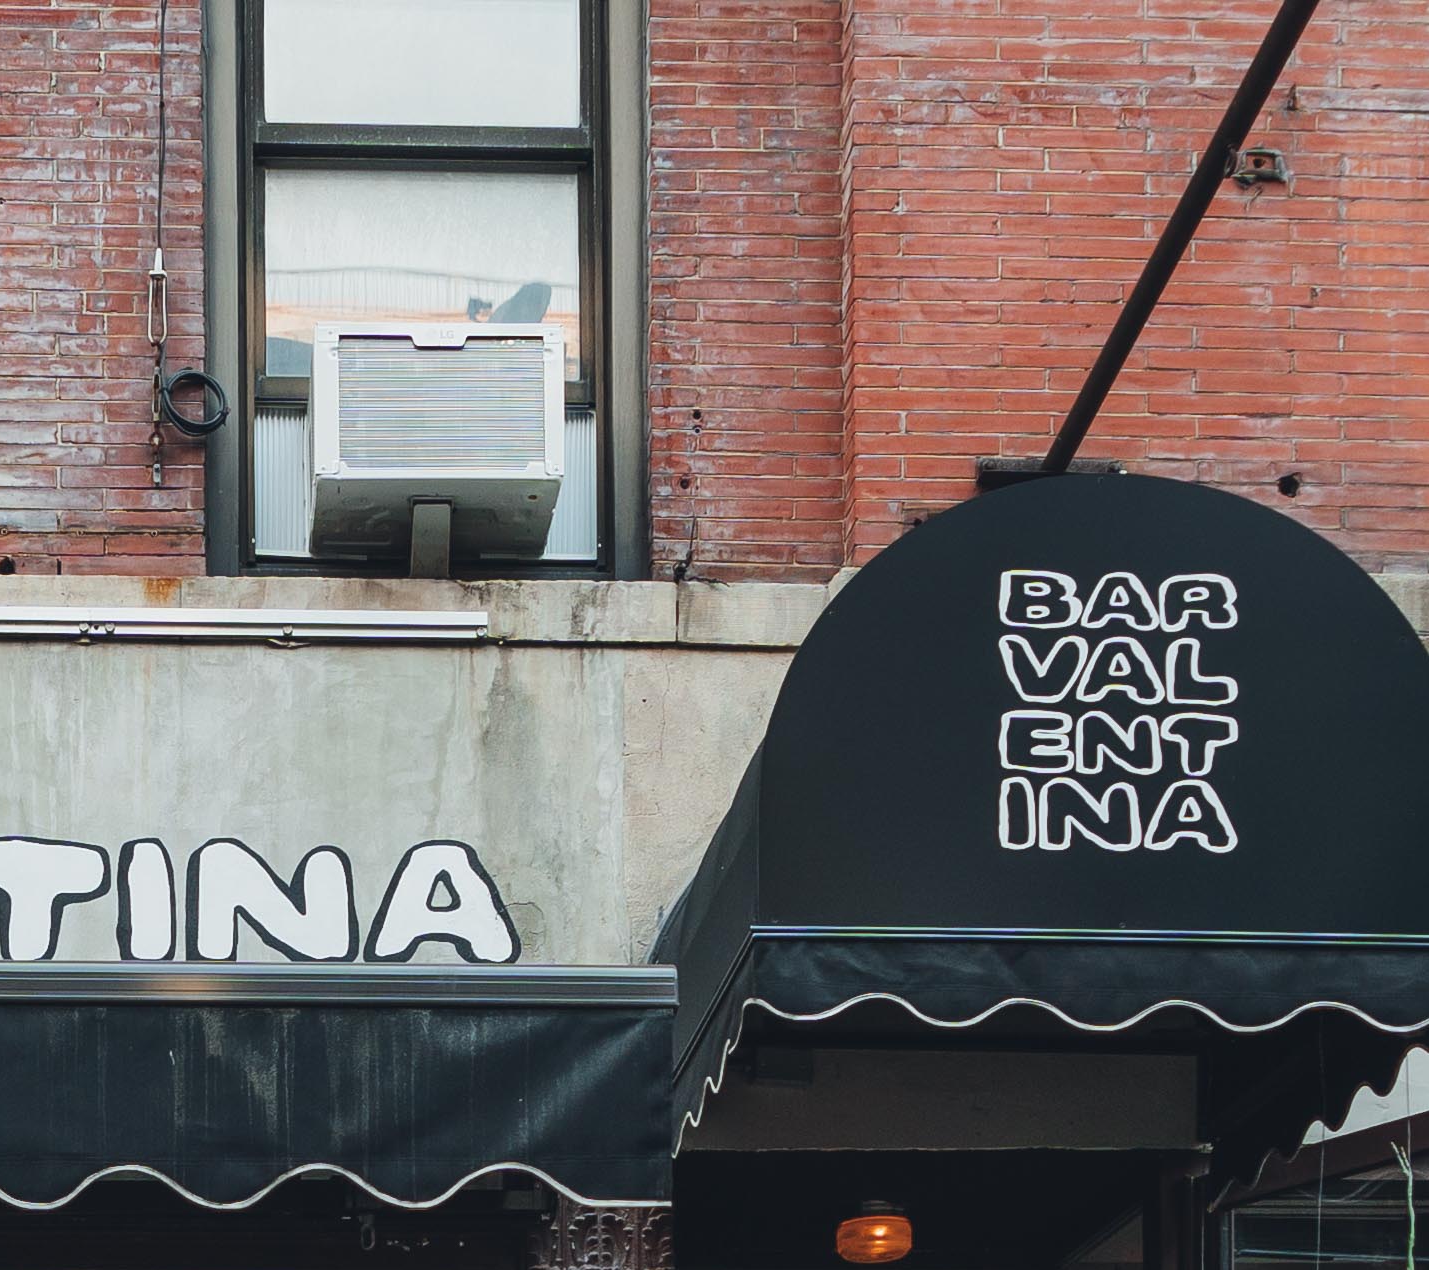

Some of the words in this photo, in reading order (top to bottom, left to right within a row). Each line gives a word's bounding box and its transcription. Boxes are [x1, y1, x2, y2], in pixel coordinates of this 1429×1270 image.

[998, 569, 1238, 633] BAR
[998, 636, 1238, 706] VAL
[998, 709, 1238, 777] ENT
[998, 777, 1238, 854] INA
